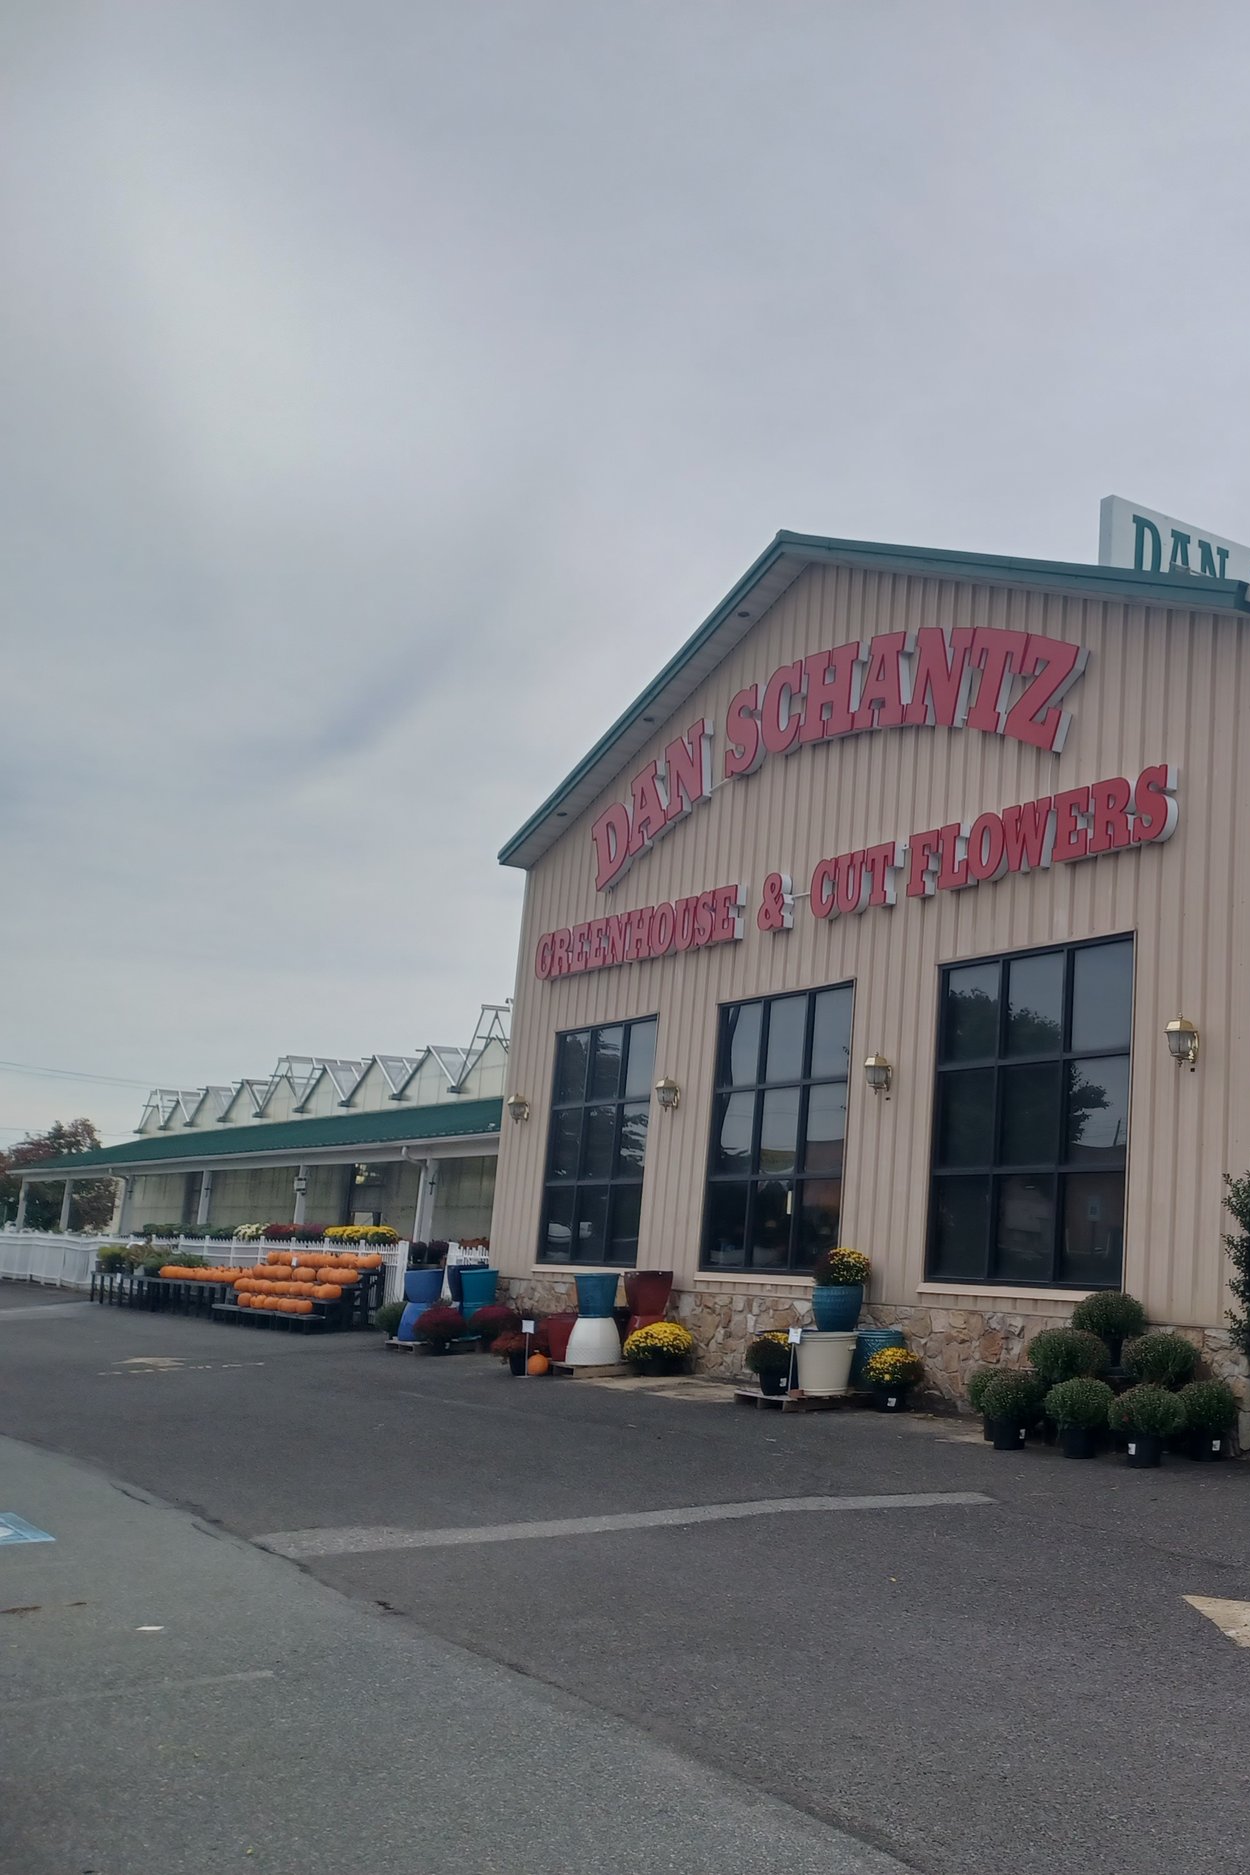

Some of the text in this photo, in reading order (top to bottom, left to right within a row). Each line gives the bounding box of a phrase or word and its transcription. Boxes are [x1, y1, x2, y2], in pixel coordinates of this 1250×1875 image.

[535, 764, 1174, 981] GREENHOUSE & CUT FLOWERS
[592, 626, 1083, 893] DAN SCHANTZ
